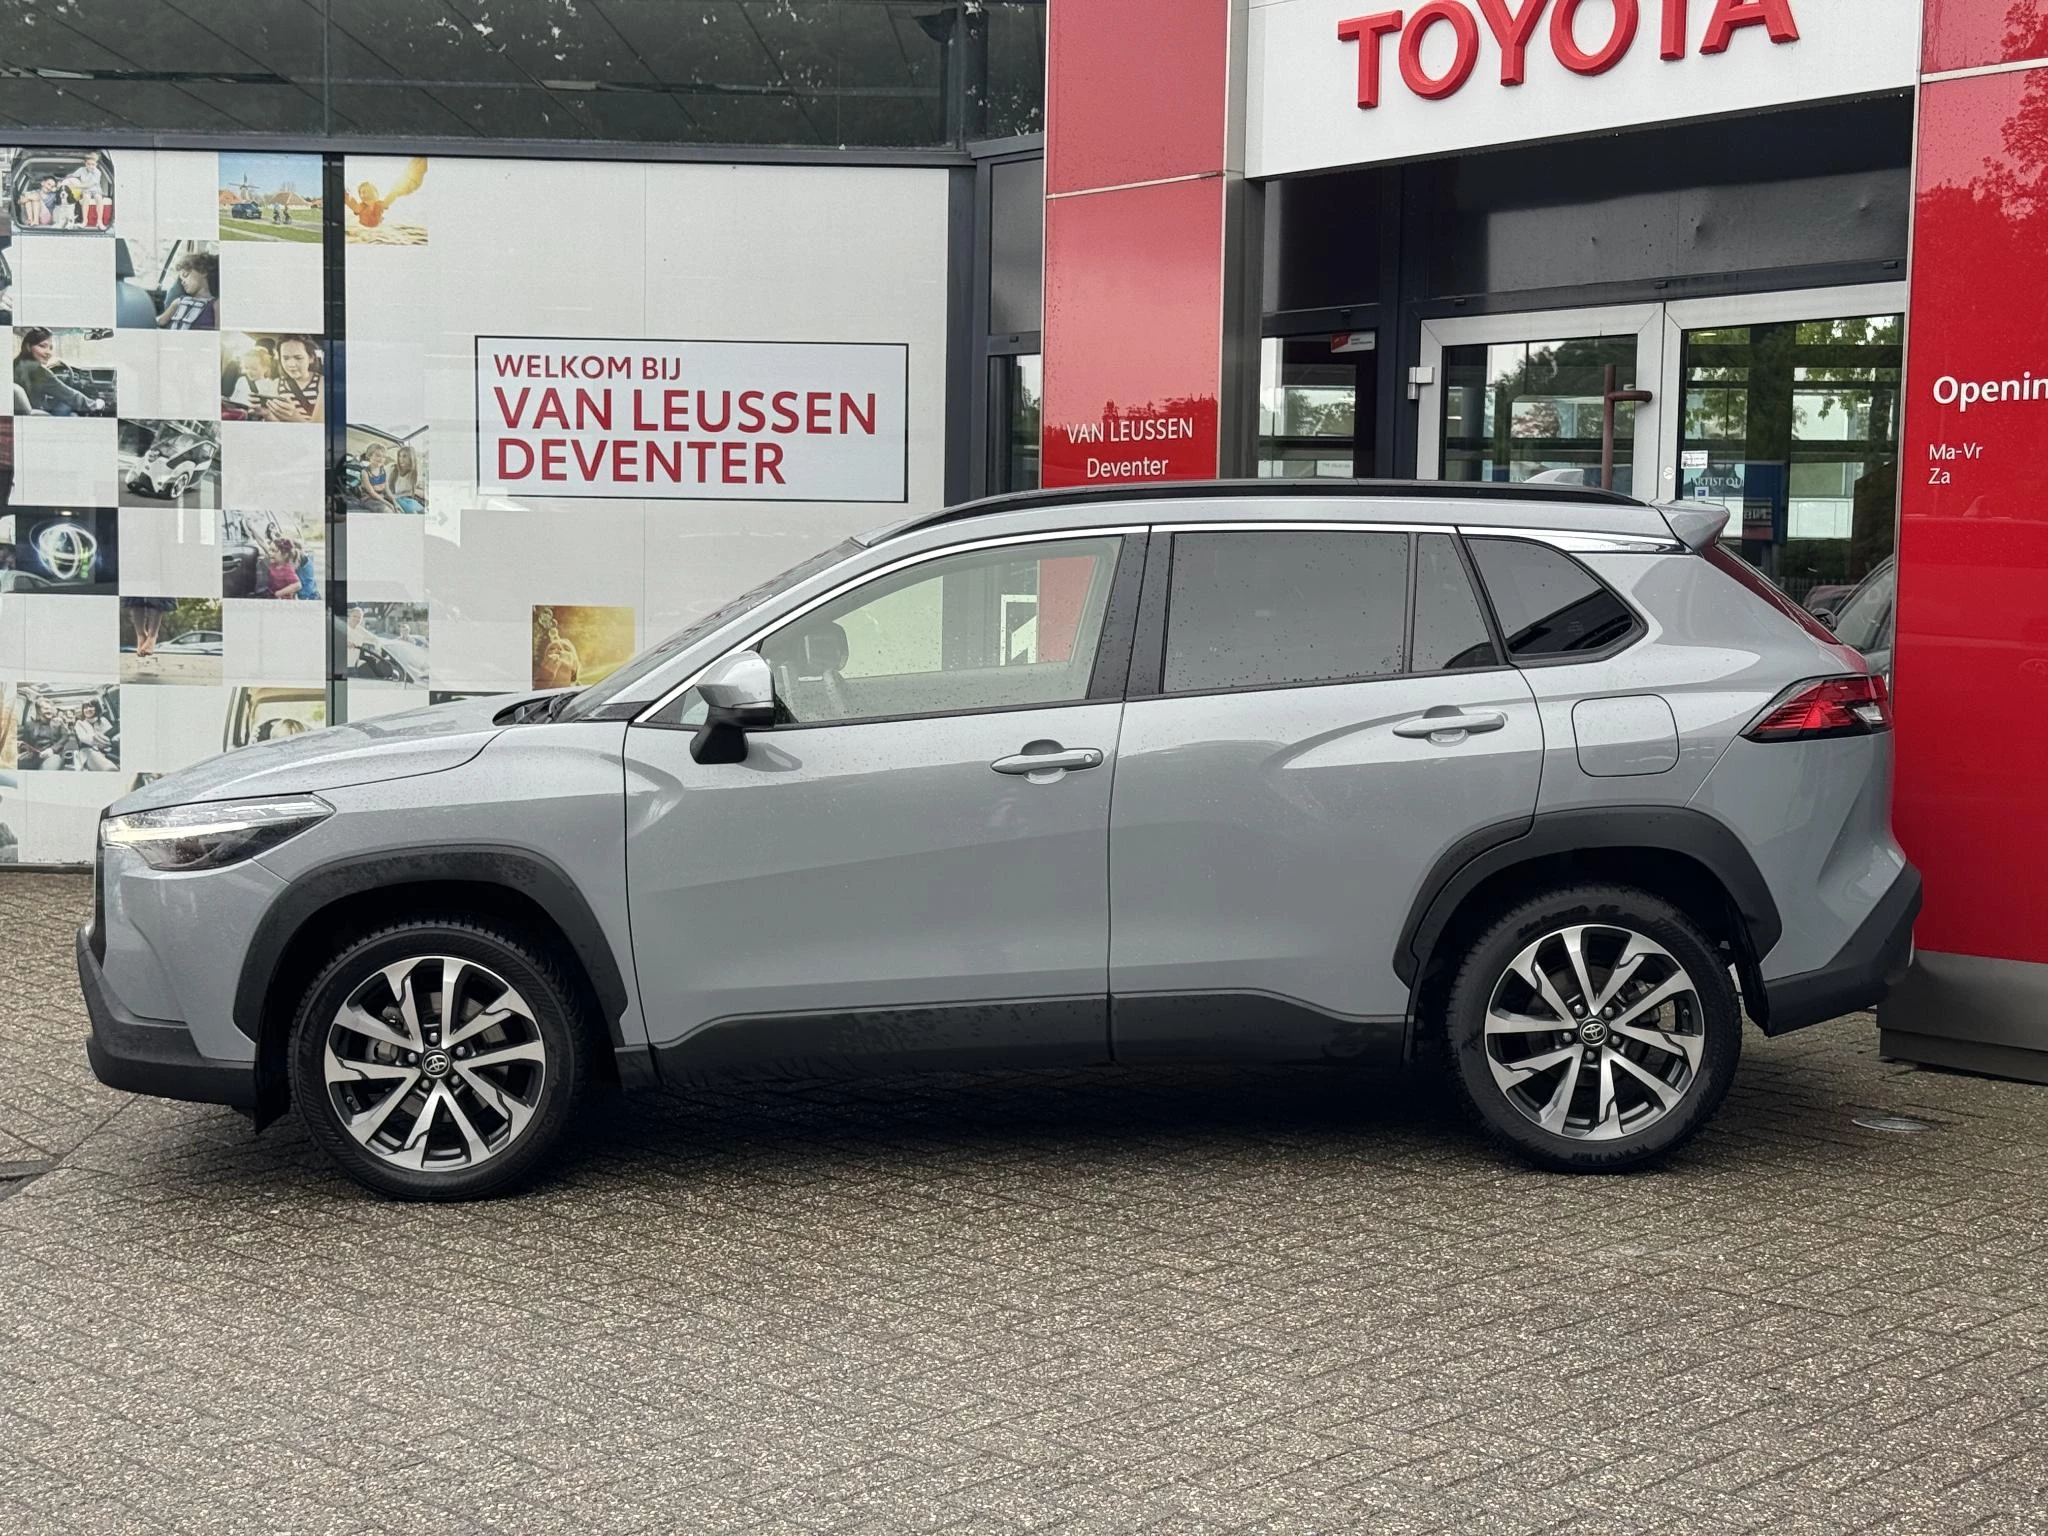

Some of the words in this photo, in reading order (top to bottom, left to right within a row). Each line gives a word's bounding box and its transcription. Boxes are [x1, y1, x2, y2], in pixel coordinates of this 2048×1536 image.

[494, 354, 632, 380] WELKOM
[643, 356, 681, 381] BIJ
[1933, 371, 2048, 413] Openin
[494, 386, 612, 431] VAN
[633, 388, 876, 435] LEUSSEN
[1066, 423, 1104, 444] VAN
[1110, 417, 1193, 442] LEUSSEN
[498, 437, 787, 485] DEVENTER
[1929, 442, 1984, 461] Ma-Vr
[1087, 457, 1169, 478] Deventer
[1928, 467, 1951, 484] Za
